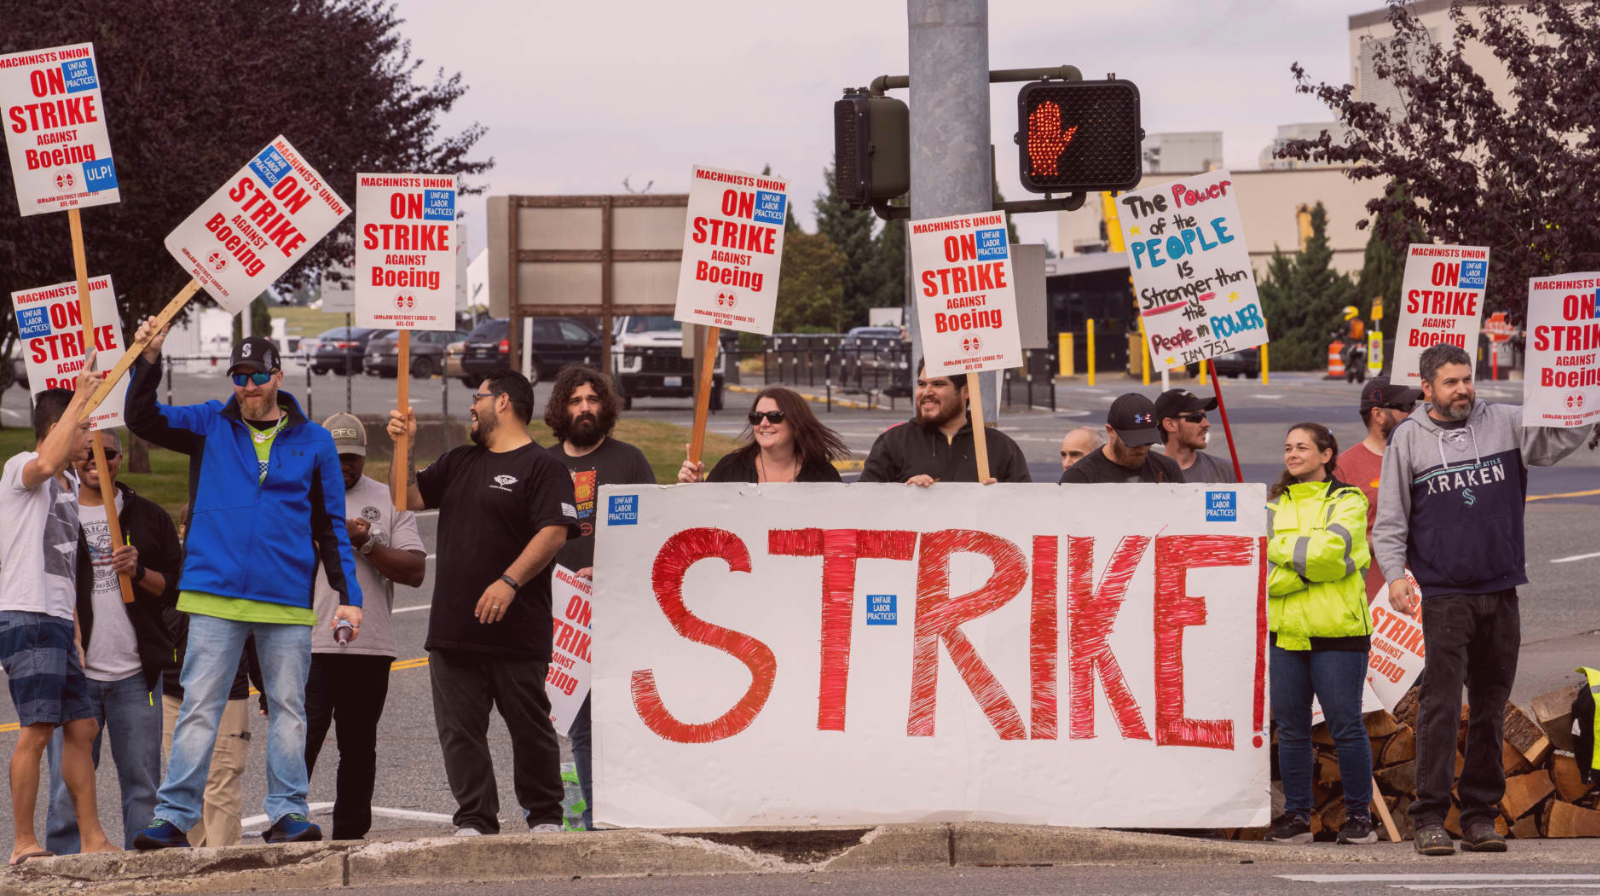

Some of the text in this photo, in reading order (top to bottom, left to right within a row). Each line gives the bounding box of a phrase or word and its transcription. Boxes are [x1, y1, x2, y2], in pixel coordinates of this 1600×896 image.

[0, 47, 89, 69] MACHINISTS UNION
[67, 60, 88, 70] UNFAIR
[30, 67, 66, 97] ON
[66, 75, 96, 88] PRACTICES!
[70, 69, 89, 79] LABOR
[9, 95, 98, 134] STRIKE
[36, 129, 77, 146] AGAINST
[25, 144, 96, 170] Boeing
[263, 156, 281, 174] LABOR
[270, 150, 287, 168] UNFAIR
[86, 165, 113, 181] ULP!
[274, 140, 346, 217] MACHINISTS UNION
[361, 177, 453, 188] MACHINISTS UNION
[696, 168, 786, 192] MACHINISTS UNION
[272, 175, 313, 216] ON
[430, 191, 450, 200] UNFAIR
[431, 199, 449, 208] LABOR
[721, 188, 755, 220] ON
[761, 193, 781, 202] UNFAIR
[1122, 180, 1232, 219] The Power
[390, 192, 423, 219] ON
[424, 207, 454, 217] PRACTICES!
[754, 208, 785, 221] PRACTICES!
[760, 201, 780, 211] LABOR
[228, 176, 308, 259] STRIKE
[913, 214, 1003, 235] MACHINISTS UNION
[1149, 214, 1198, 235] of the
[231, 213, 269, 251] AGAINST
[363, 223, 449, 252] STRIKE
[692, 216, 777, 255] STRIKE
[981, 230, 1000, 239] UNFAIR
[204, 211, 266, 278] Boeing
[944, 233, 977, 263] ON
[978, 246, 1007, 256] PRACTICES!
[983, 238, 1001, 248] LABOR
[1131, 216, 1235, 270] PEOPLE
[385, 254, 427, 266] AGAINST
[710, 249, 752, 267] AGAINST
[1411, 247, 1487, 260] MACHINISTS UNION
[1431, 261, 1461, 287] ON
[1465, 261, 1482, 270] UNFAIR
[1465, 269, 1481, 277] LABOR
[371, 266, 441, 290] Boeing
[695, 259, 764, 293] Boeing
[921, 261, 1007, 298] STRIKE
[1534, 278, 1595, 291] MACHINISTS
[17, 279, 108, 305] MACHINISTS ION
[1140, 267, 1248, 310] Stronger than
[946, 294, 987, 310] AGAINST
[1407, 289, 1479, 317] STRIKE
[1563, 293, 1596, 321] ON
[22, 308, 42, 319] UNFAIR
[24, 316, 43, 327] LABOR
[50, 299, 82, 330] ON
[934, 308, 1002, 333] Boeing
[1181, 304, 1208, 322] the
[1150, 326, 1198, 356] People
[1210, 302, 1265, 340] POWER
[1422, 318, 1456, 329] AGAINST
[29, 324, 117, 364] STRIKE
[1408, 328, 1466, 350] Boeing
[1534, 323, 1600, 351] STRIK
[1180, 339, 1236, 366] IAM 751
[1556, 353, 1596, 366] AGAINST
[57, 358, 85, 375] AGAIN
[613, 496, 633, 505] UNFAIR
[1211, 492, 1231, 501] UNFAIR
[1212, 500, 1230, 509] LABOR
[608, 512, 637, 521] PRACTICES!
[614, 504, 632, 513] LABOR
[1206, 508, 1235, 518] PRACTICES!
[555, 570, 592, 596] MACHINIS
[872, 595, 891, 604] UNFAIR
[873, 603, 891, 612] LABOR
[565, 594, 592, 628] ON
[867, 611, 897, 621] PRACTICES!
[631, 526, 1268, 750] STRIKE!
[1371, 637, 1405, 660] AGAINST
[1369, 650, 1406, 684] eing
